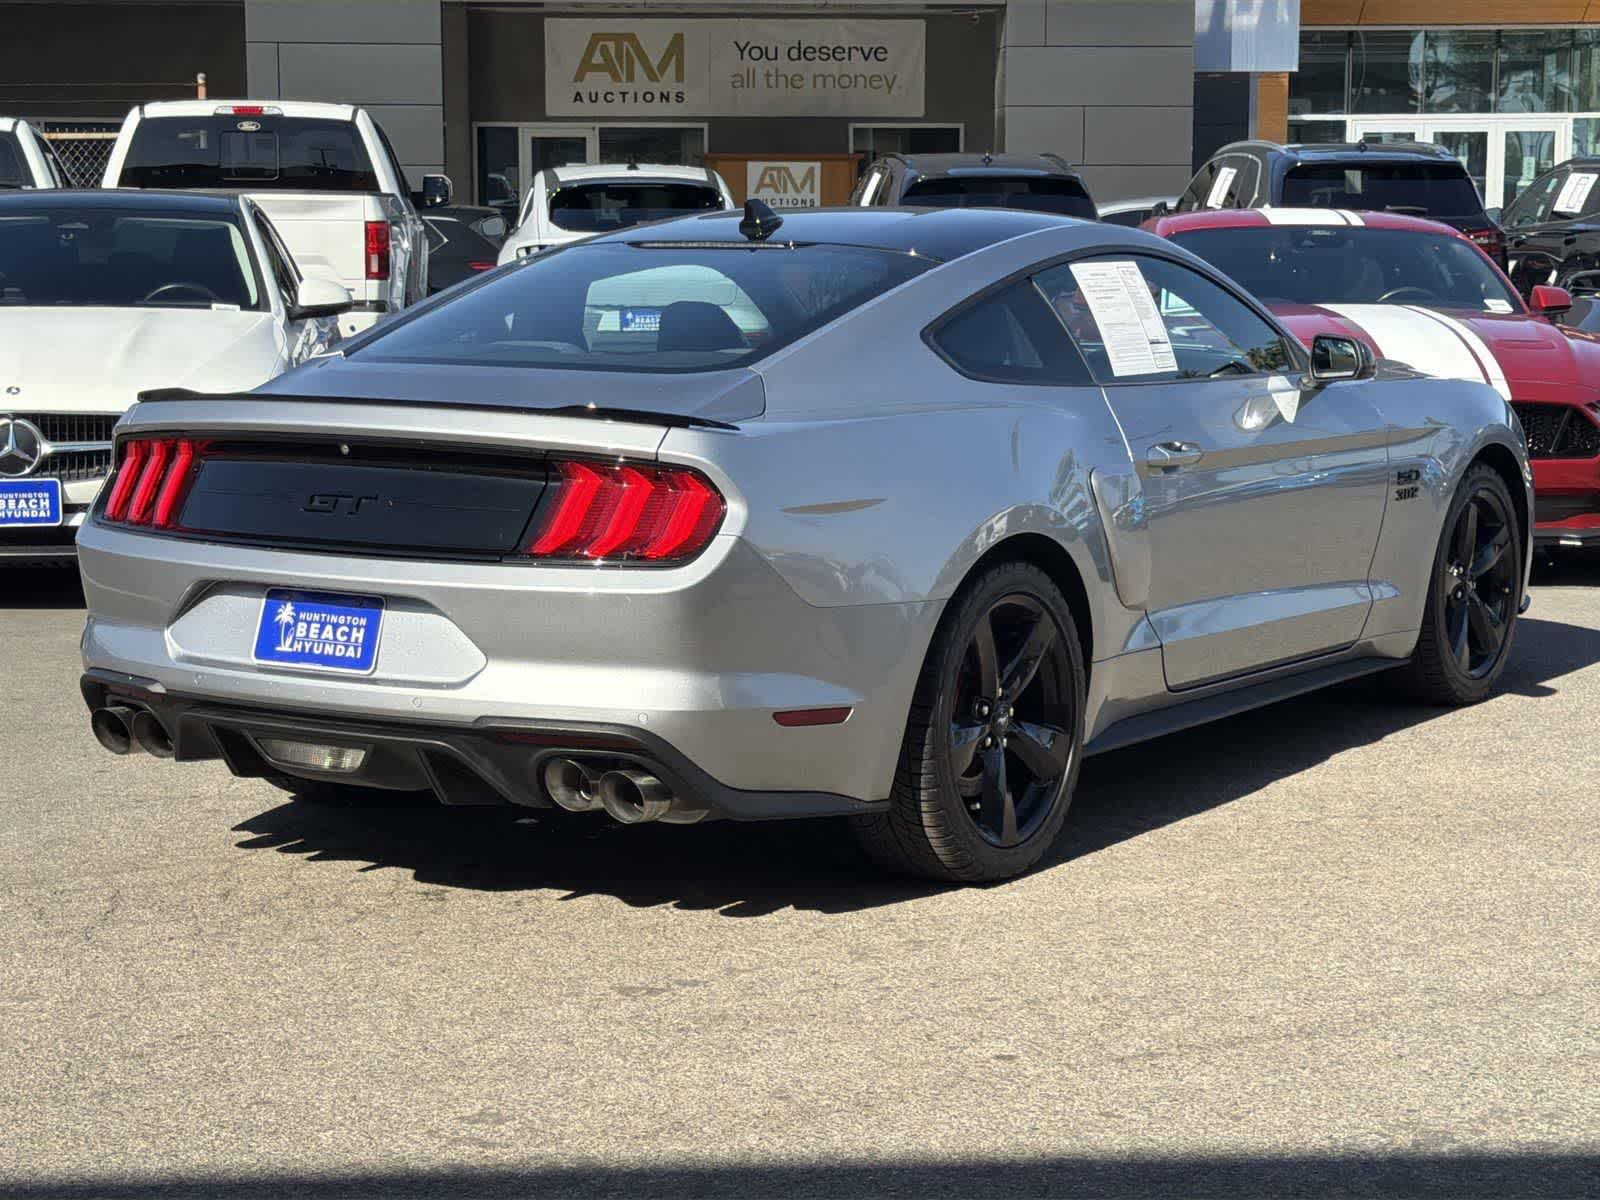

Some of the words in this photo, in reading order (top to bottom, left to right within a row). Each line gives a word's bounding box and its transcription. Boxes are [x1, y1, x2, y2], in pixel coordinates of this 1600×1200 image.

[573, 32, 685, 83] ATM
[734, 41, 778, 61] You
[787, 40, 888, 62] deserve
[731, 68, 756, 89] all
[764, 68, 805, 89] the
[573, 91, 686, 104] AUCTIONS
[753, 166, 815, 193] ATM
[302, 493, 380, 515] GT
[299, 611, 368, 626] HUNTINGTON
[295, 621, 366, 643] BEACH
[293, 639, 363, 659] HYUNDAI
